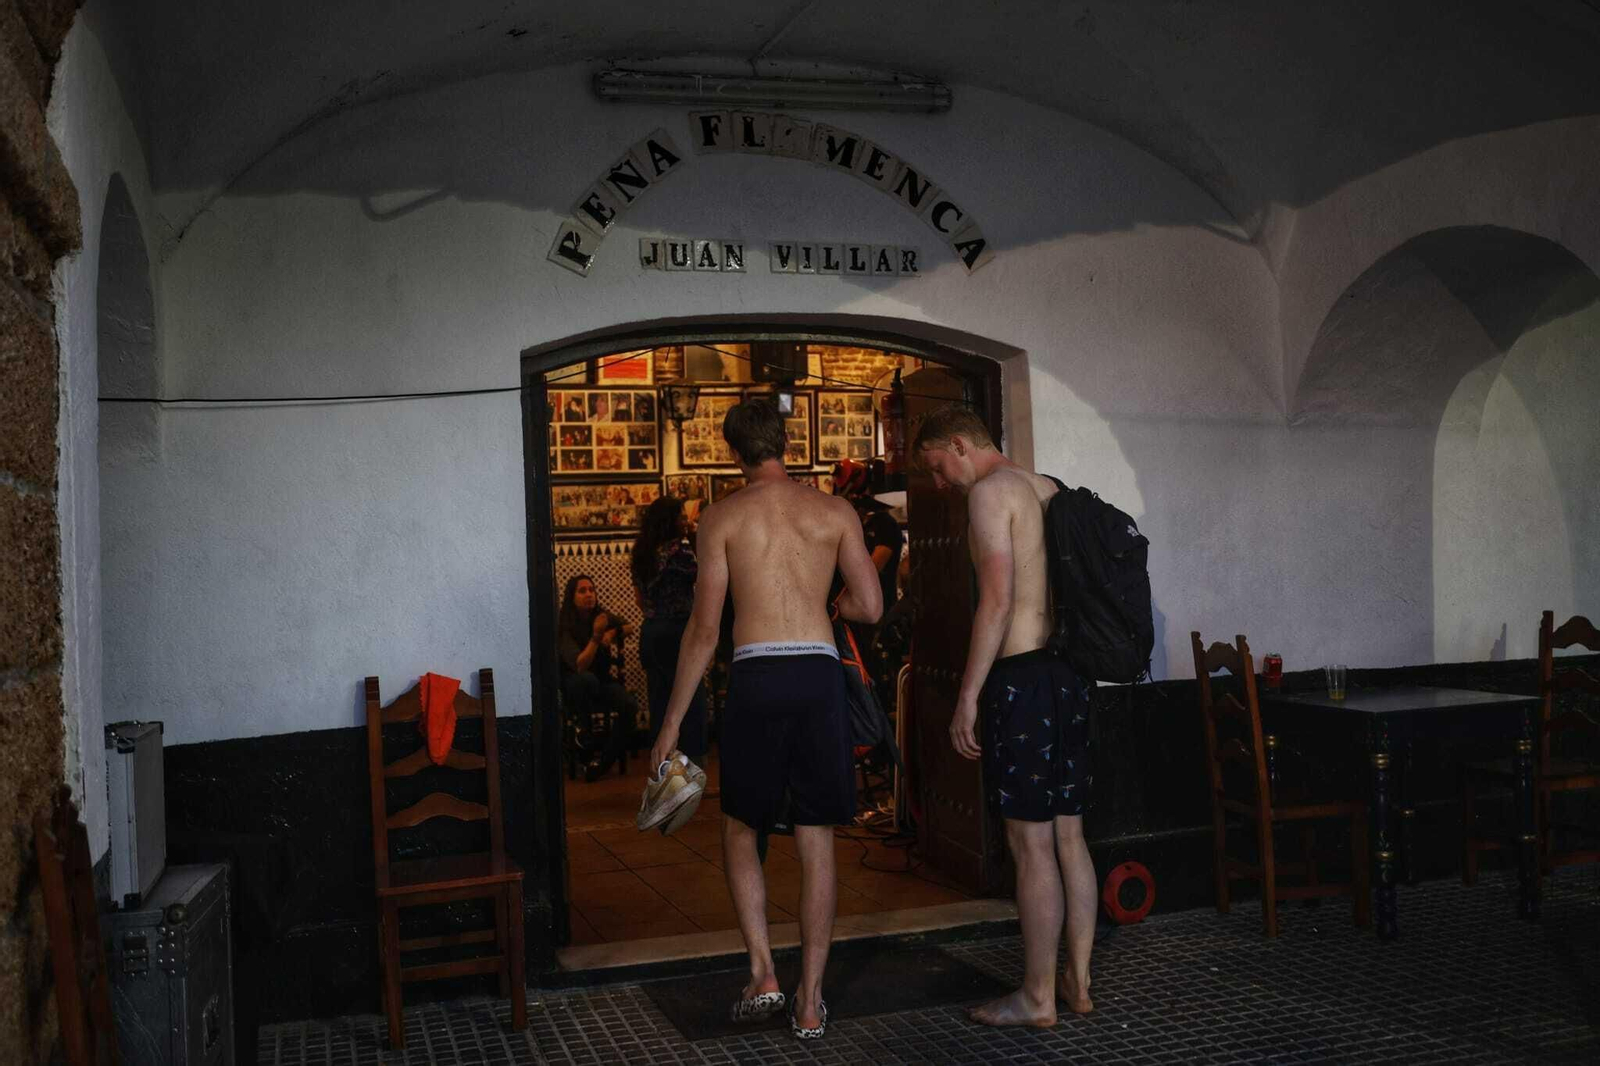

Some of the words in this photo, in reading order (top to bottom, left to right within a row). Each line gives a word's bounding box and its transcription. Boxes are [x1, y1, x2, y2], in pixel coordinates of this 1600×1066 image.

[558, 139, 681, 269] PEÑA
[699, 115, 986, 269] FLMENCA
[644, 240, 744, 268] JUAN
[775, 245, 918, 272] VILLAR
